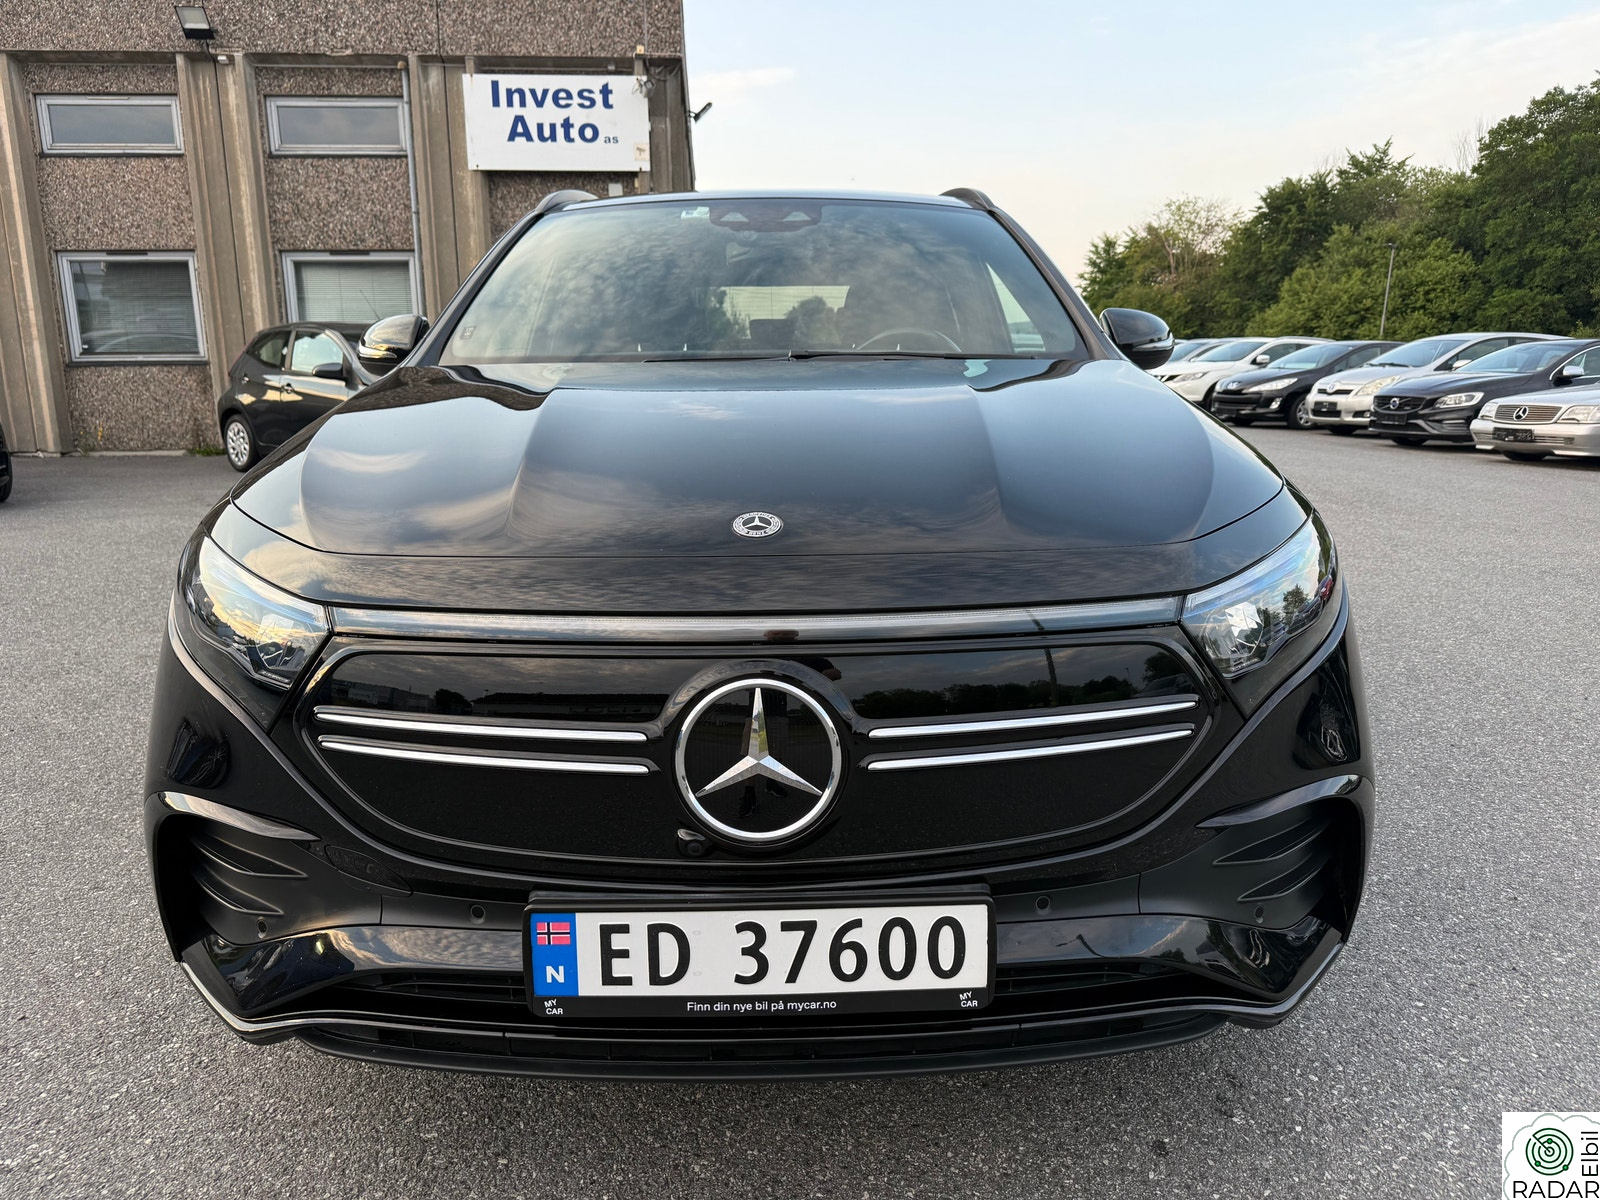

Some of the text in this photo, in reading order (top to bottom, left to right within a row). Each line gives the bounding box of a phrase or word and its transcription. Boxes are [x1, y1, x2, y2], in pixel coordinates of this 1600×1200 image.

[490, 80, 614, 109] Invest
[507, 115, 619, 144] Auto as
[599, 915, 967, 987] ED 37600
[545, 965, 565, 983] N
[959, 990, 973, 1000] MY
[543, 998, 557, 1008] MY
[686, 1000, 837, 1013] Finn din nye bil på mycar.no
[960, 1000, 979, 1008] CAR
[545, 1007, 564, 1015] CAR
